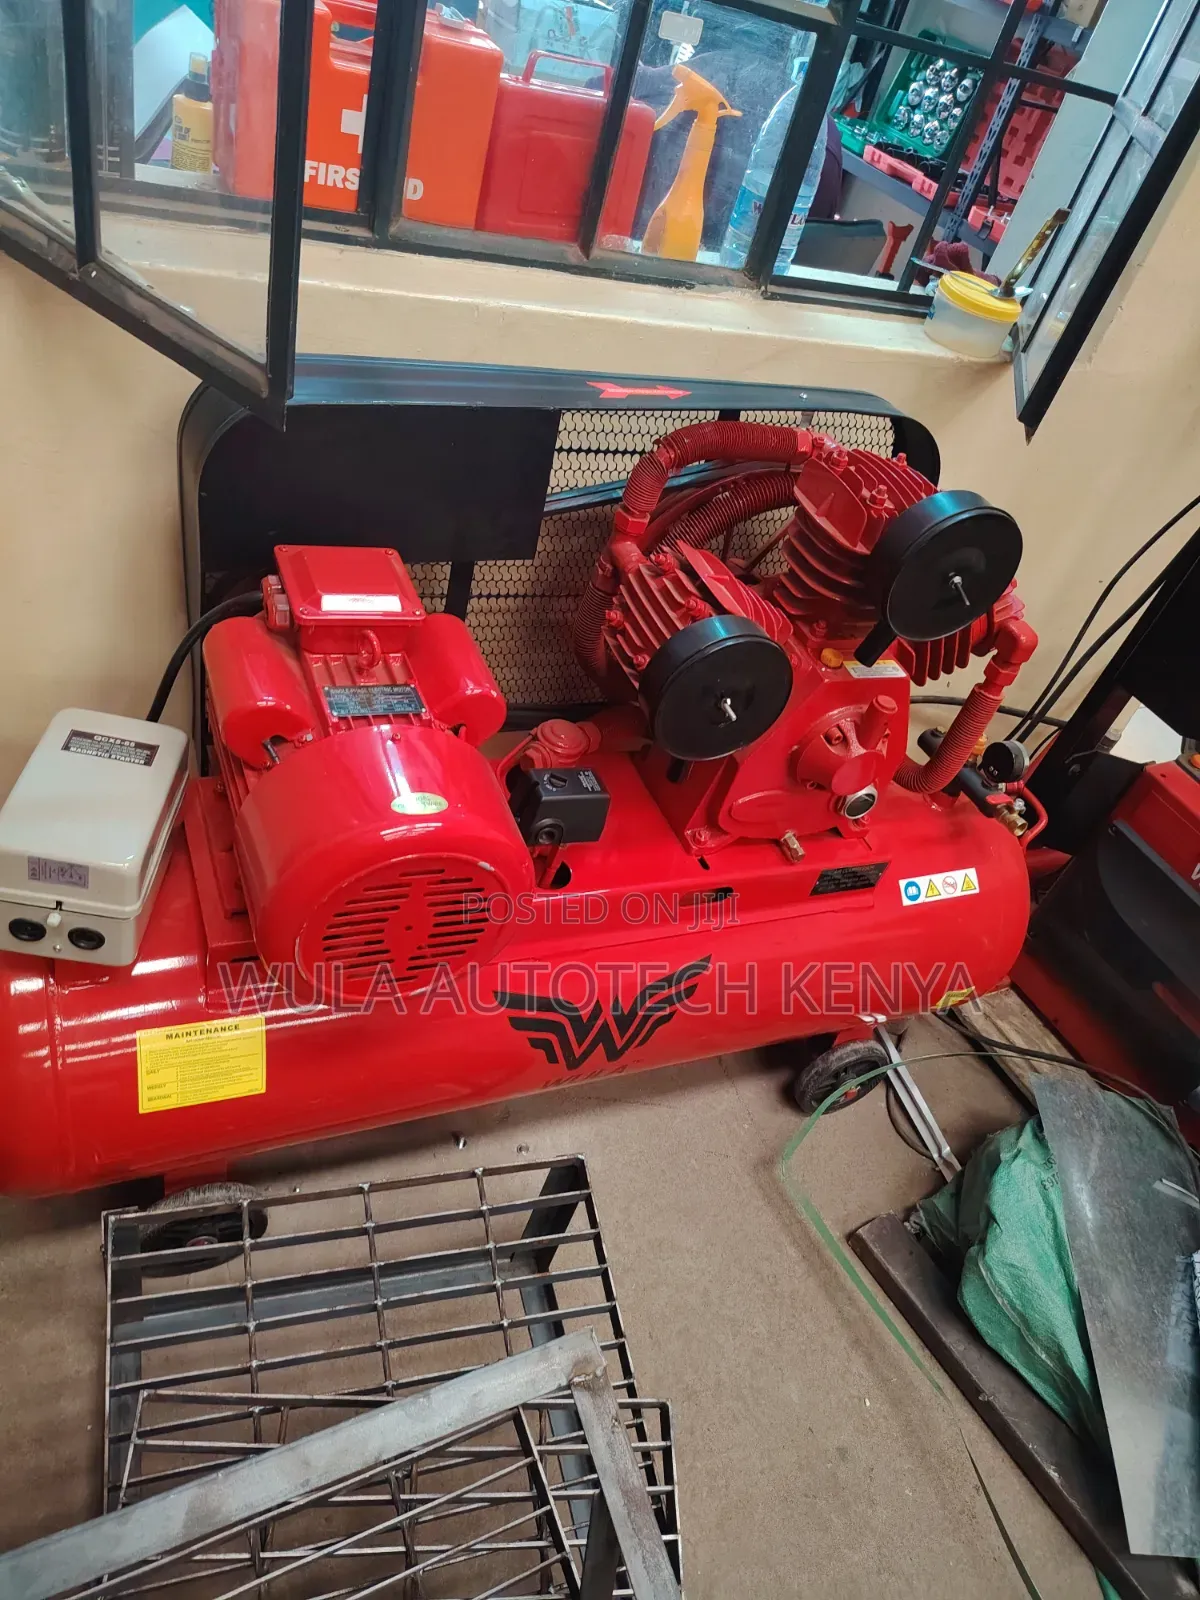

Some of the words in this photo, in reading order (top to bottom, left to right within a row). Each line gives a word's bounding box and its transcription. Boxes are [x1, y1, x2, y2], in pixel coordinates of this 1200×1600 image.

[304, 160, 360, 191] FIRS
[70, 746, 110, 758] MAGNETIC
[111, 754, 145, 765] STARTER
[165, 1024, 240, 1040] MAINTENANCE
